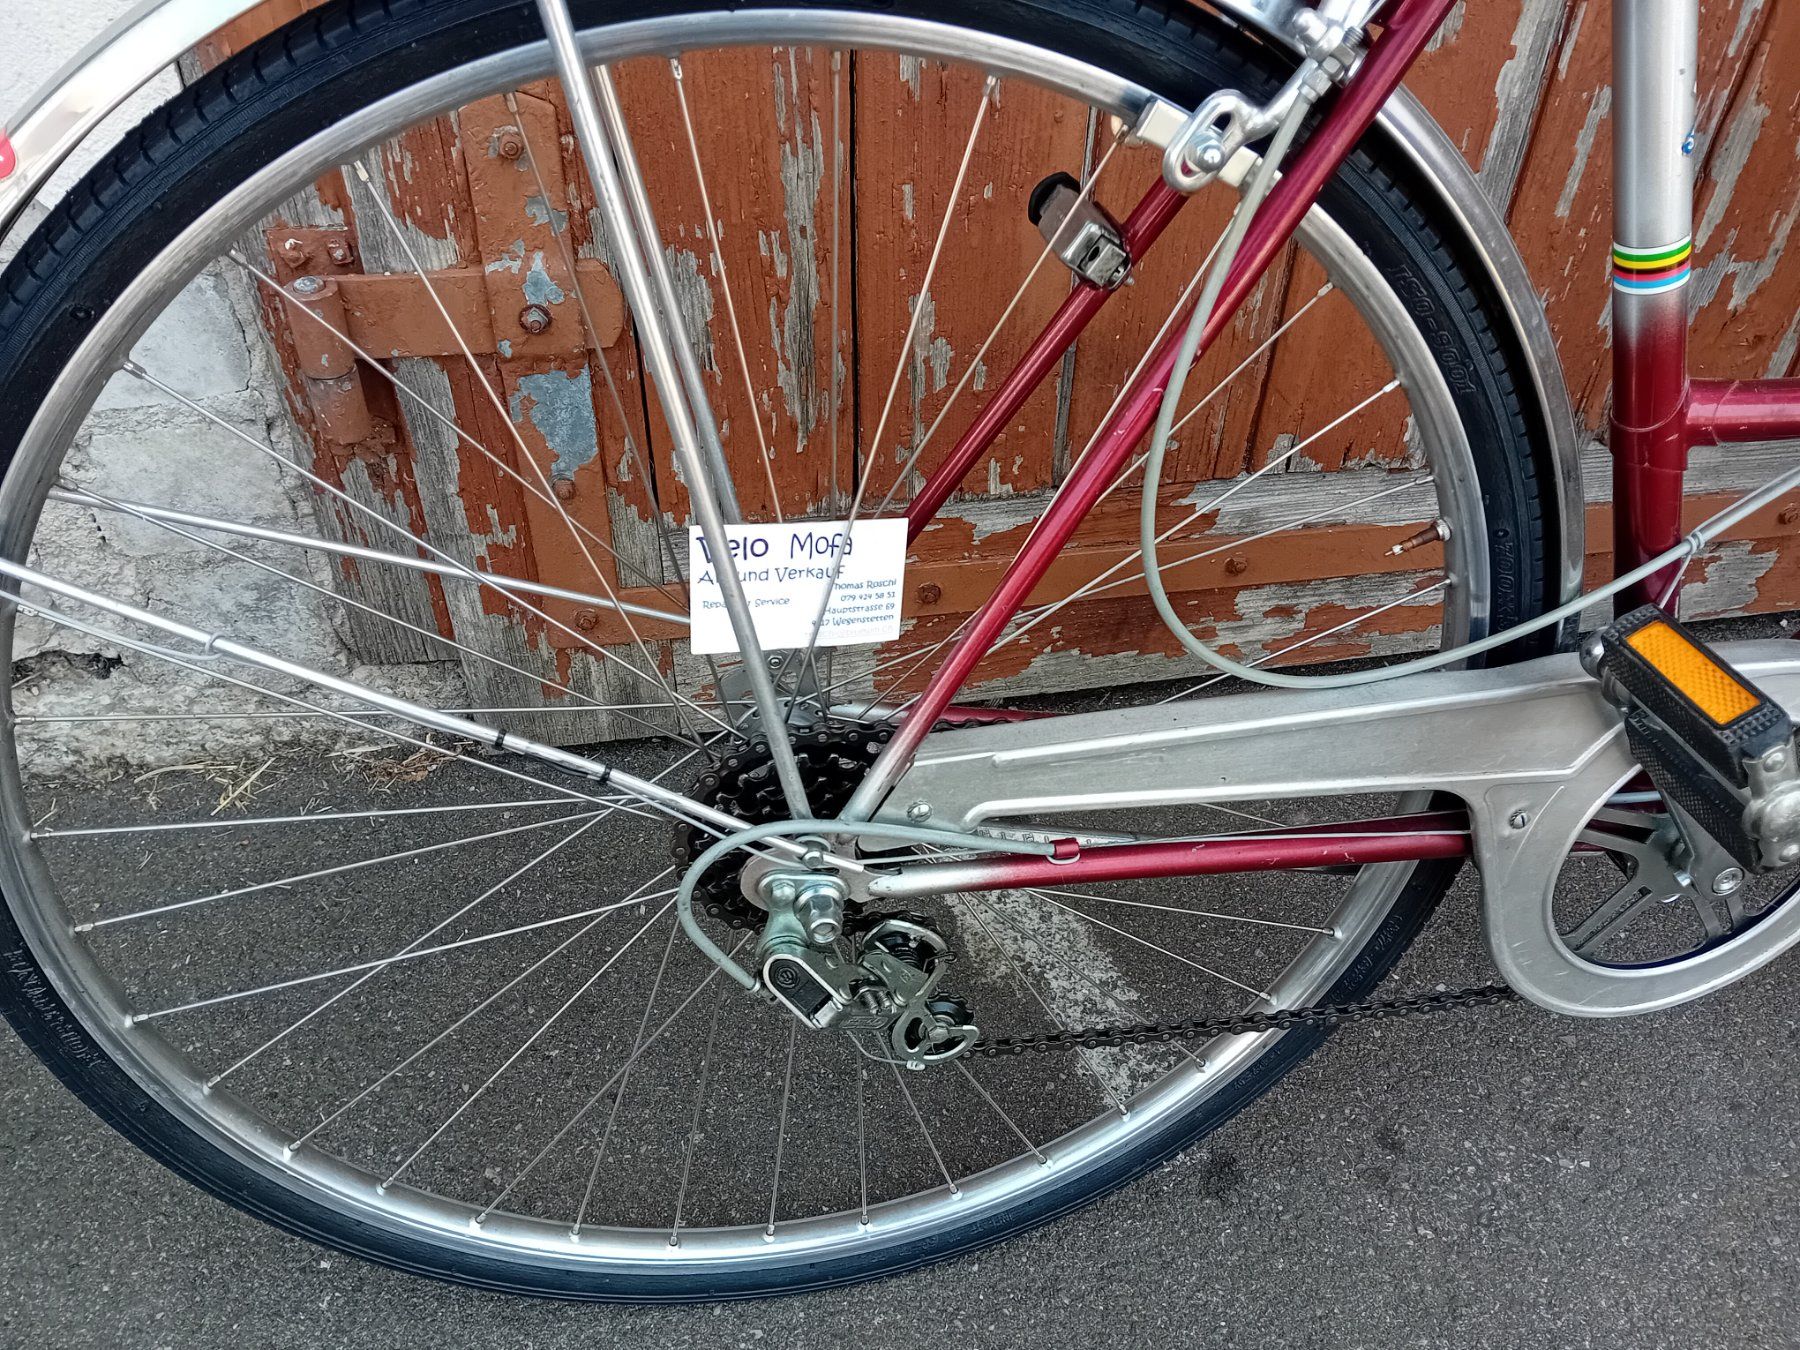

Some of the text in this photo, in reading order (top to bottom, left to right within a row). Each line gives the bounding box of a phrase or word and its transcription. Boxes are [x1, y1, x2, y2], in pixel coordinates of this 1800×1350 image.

[790, 531, 853, 560] Mofa
[738, 568, 770, 583] und
[775, 564, 846, 583] Verkauf
[832, 581, 864, 590] homas
[754, 597, 791, 608] Service
